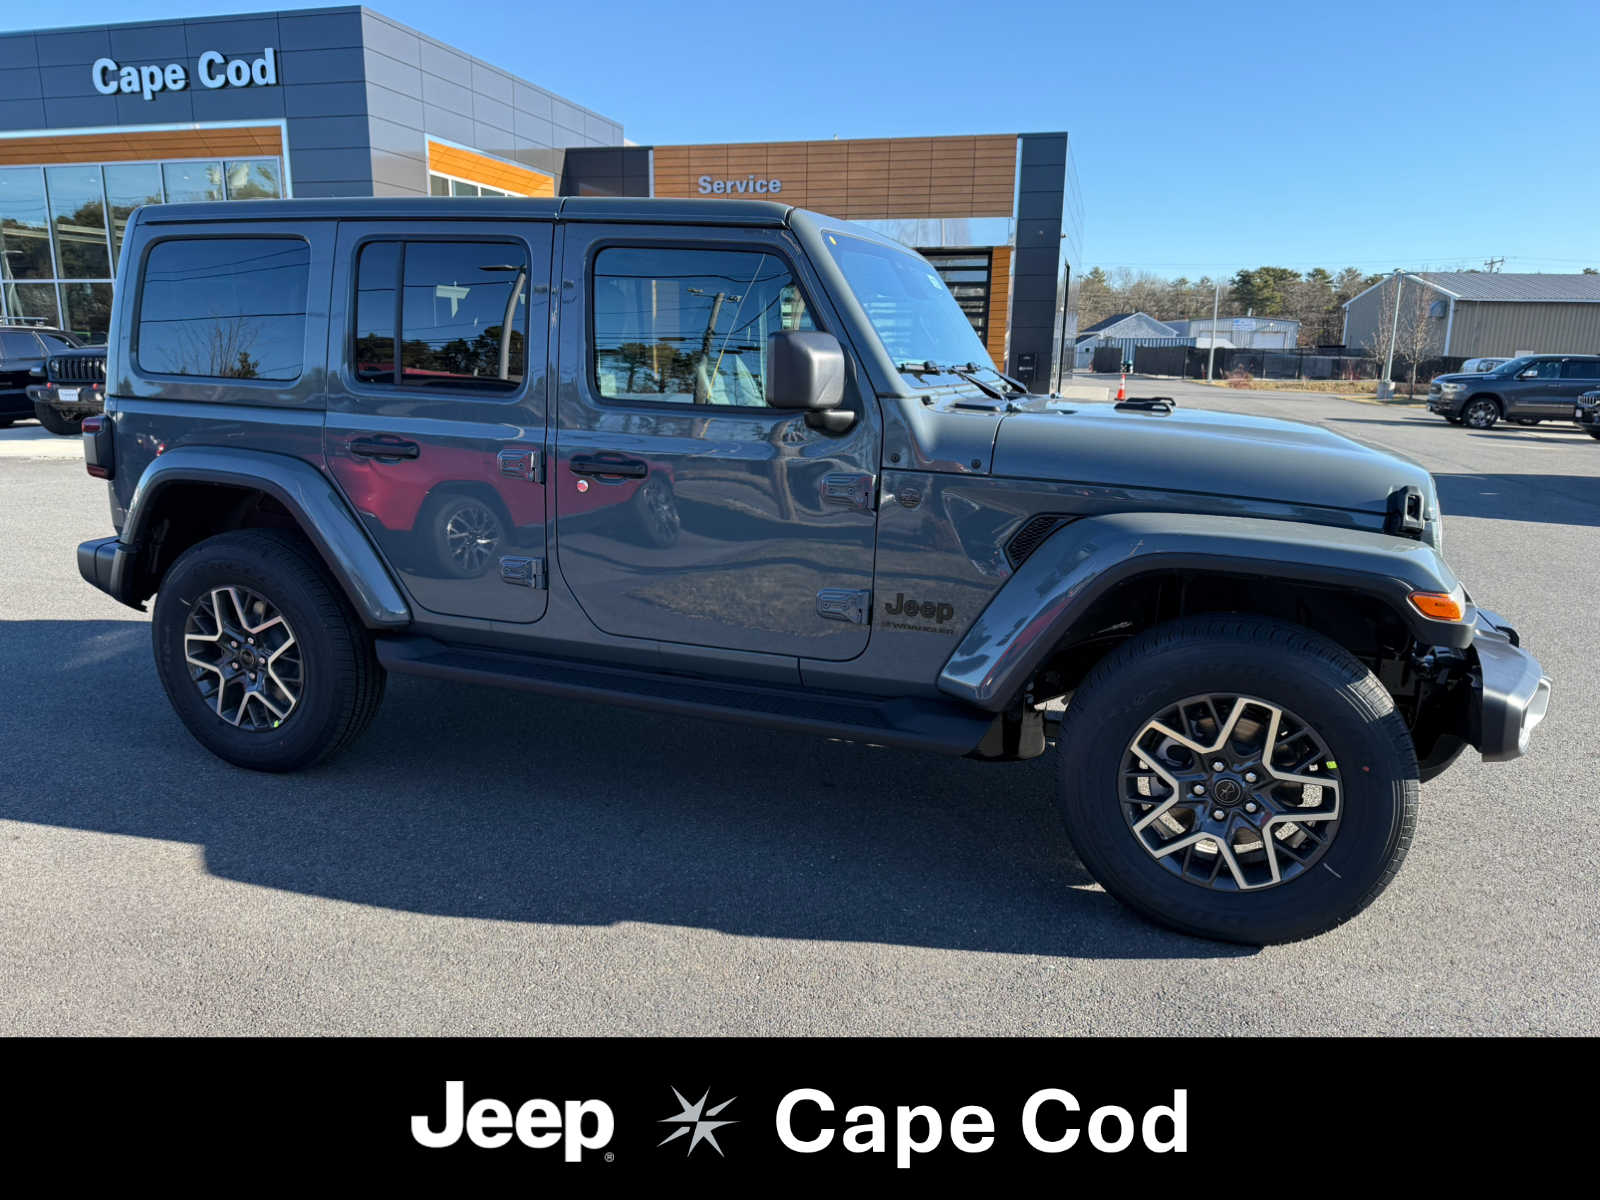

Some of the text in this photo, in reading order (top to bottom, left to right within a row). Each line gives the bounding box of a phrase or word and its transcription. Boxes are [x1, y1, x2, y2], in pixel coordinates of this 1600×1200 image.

[92, 47, 277, 101] Cape Cod
[698, 175, 782, 194] Service
[885, 593, 954, 624] Jeep
